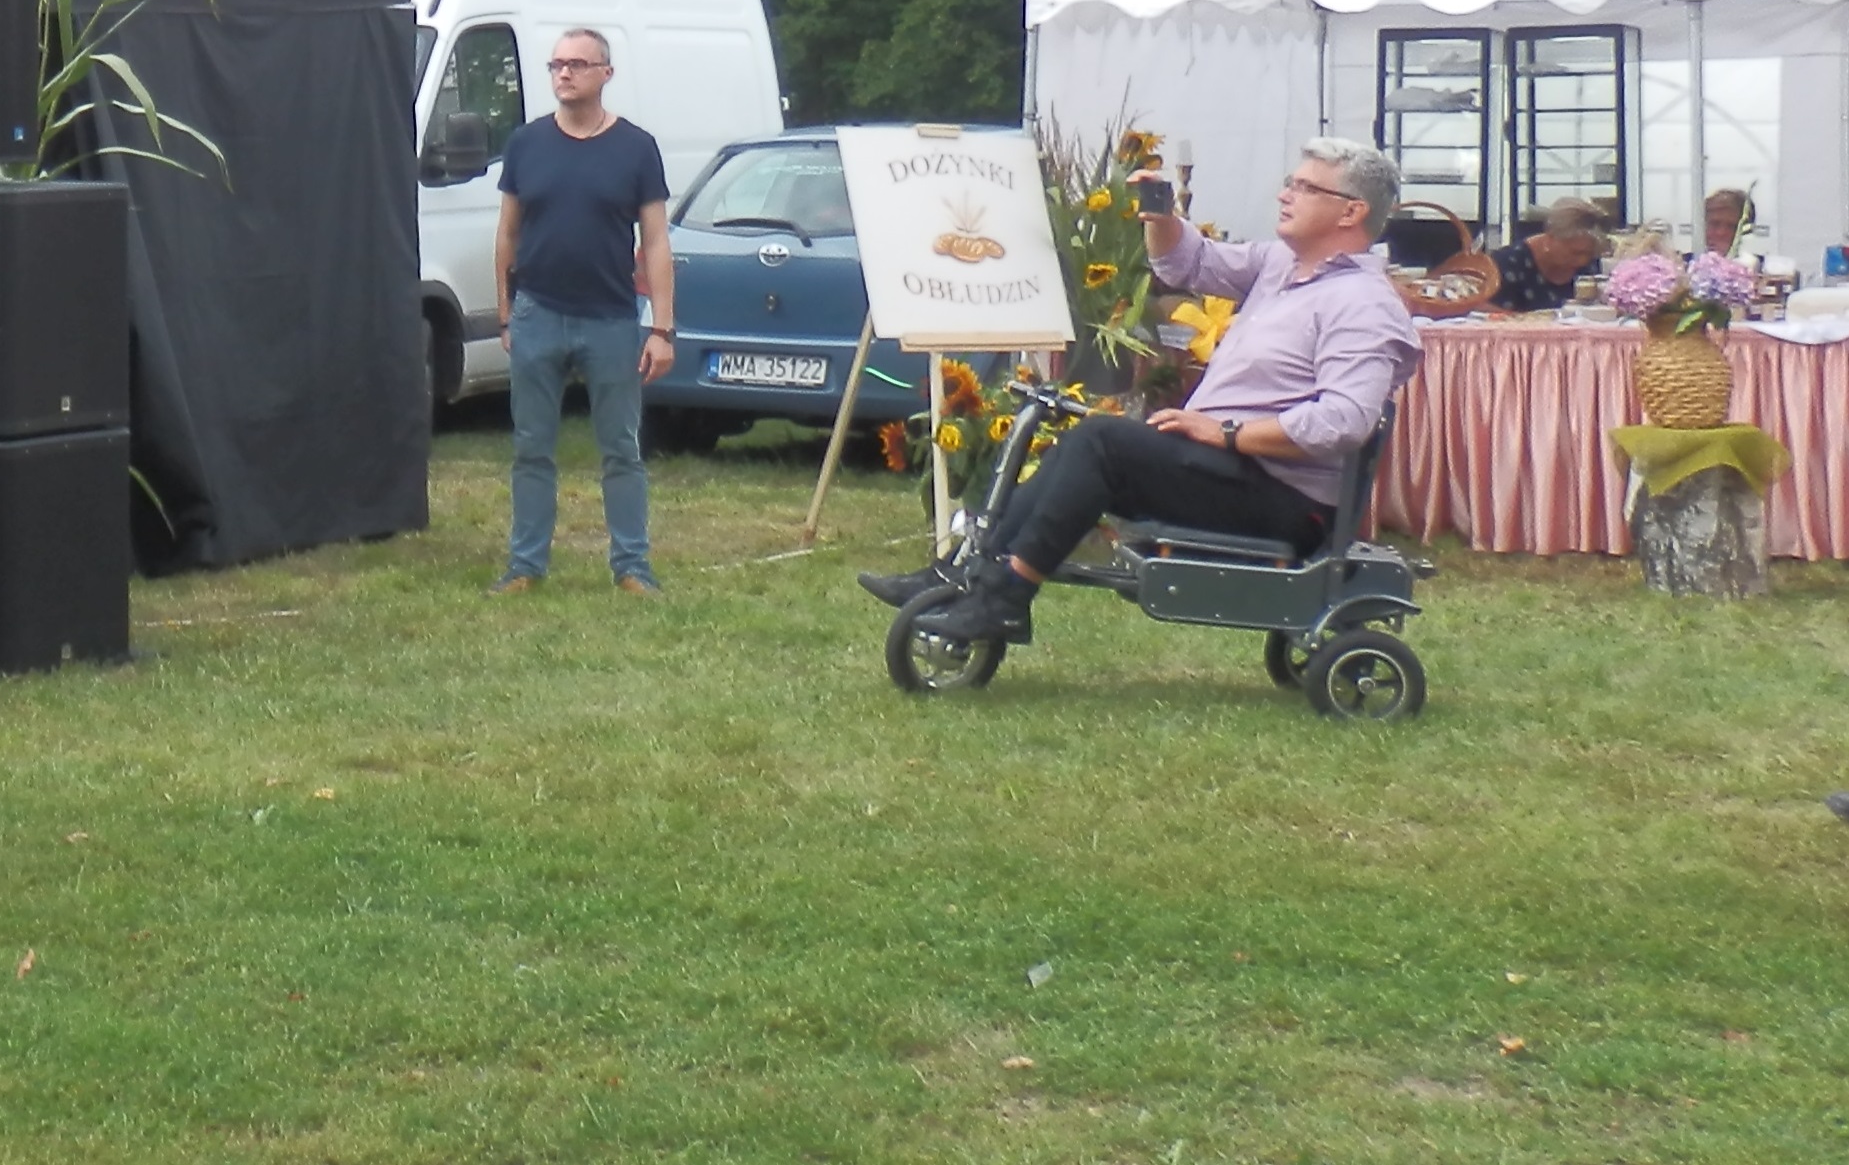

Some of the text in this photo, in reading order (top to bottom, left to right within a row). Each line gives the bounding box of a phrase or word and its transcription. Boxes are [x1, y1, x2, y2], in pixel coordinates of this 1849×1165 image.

[887, 148, 1013, 190] DOŻYNKI
[721, 355, 823, 380] WMA 35122
